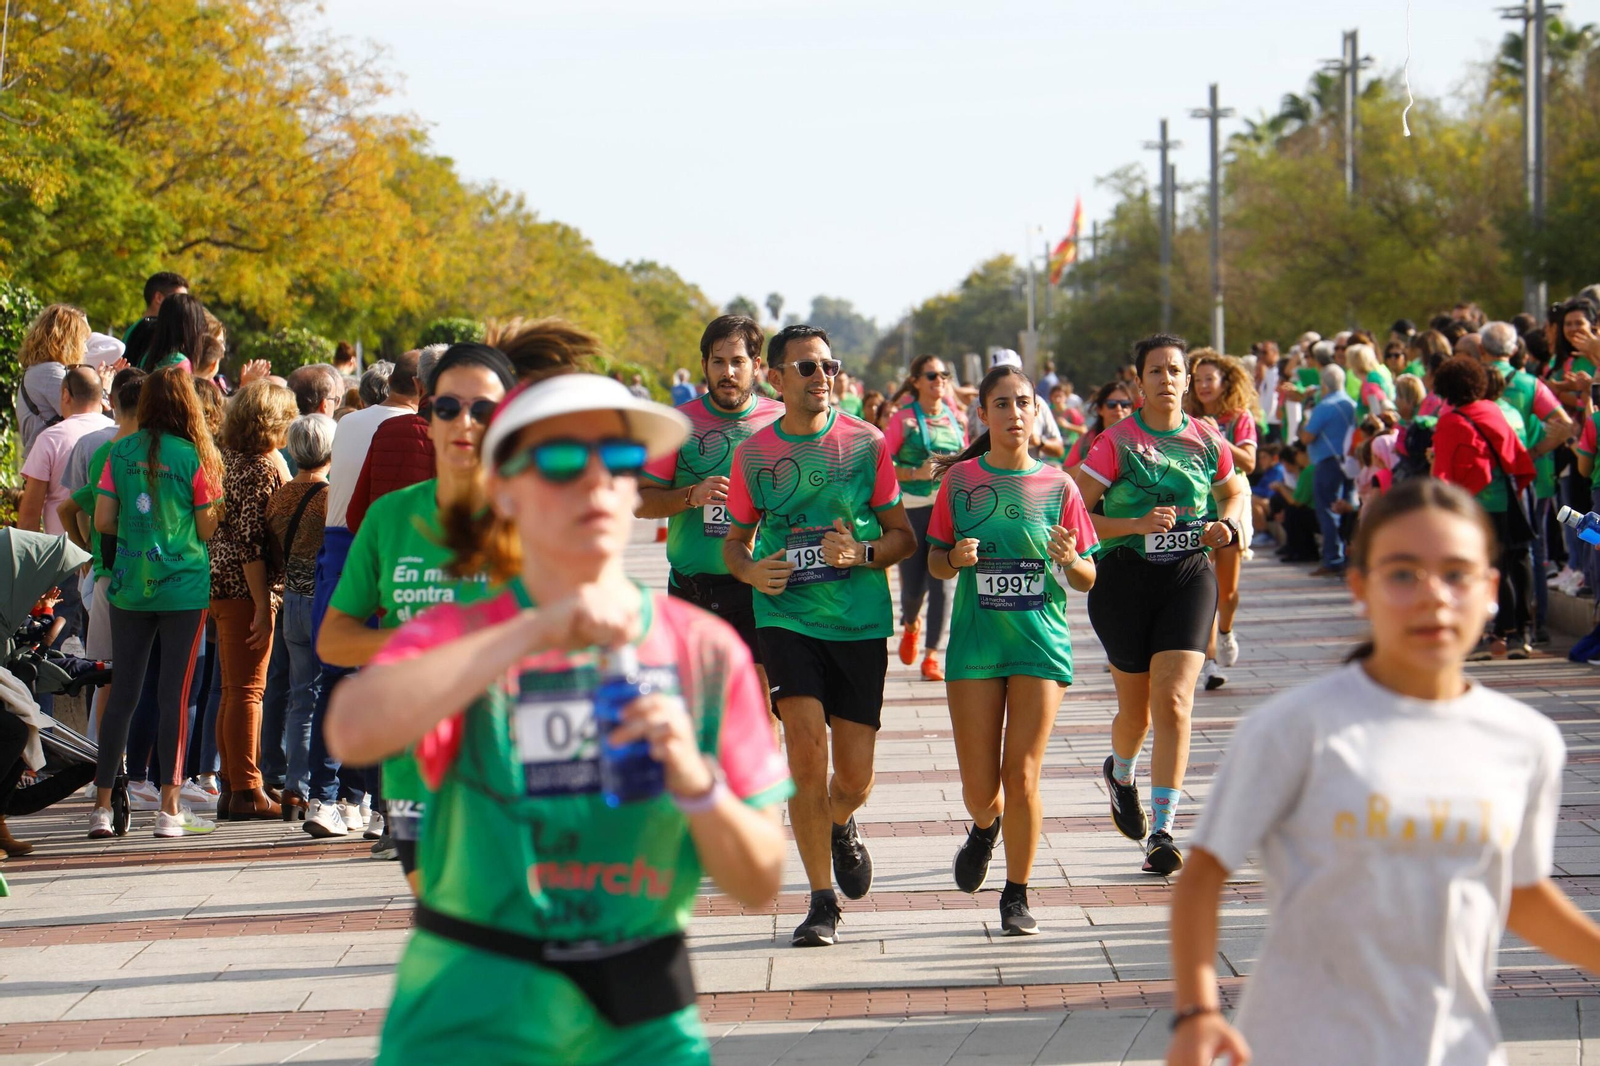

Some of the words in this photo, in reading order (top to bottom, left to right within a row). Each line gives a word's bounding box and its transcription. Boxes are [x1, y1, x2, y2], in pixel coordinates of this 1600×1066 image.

[126, 468, 142, 476] que
[1157, 493, 1176, 502] La
[786, 513, 807, 527] La
[1154, 533, 1200, 550] 2393
[393, 565, 419, 582] En
[985, 576, 1034, 593] 1997
[393, 586, 454, 602] contra
